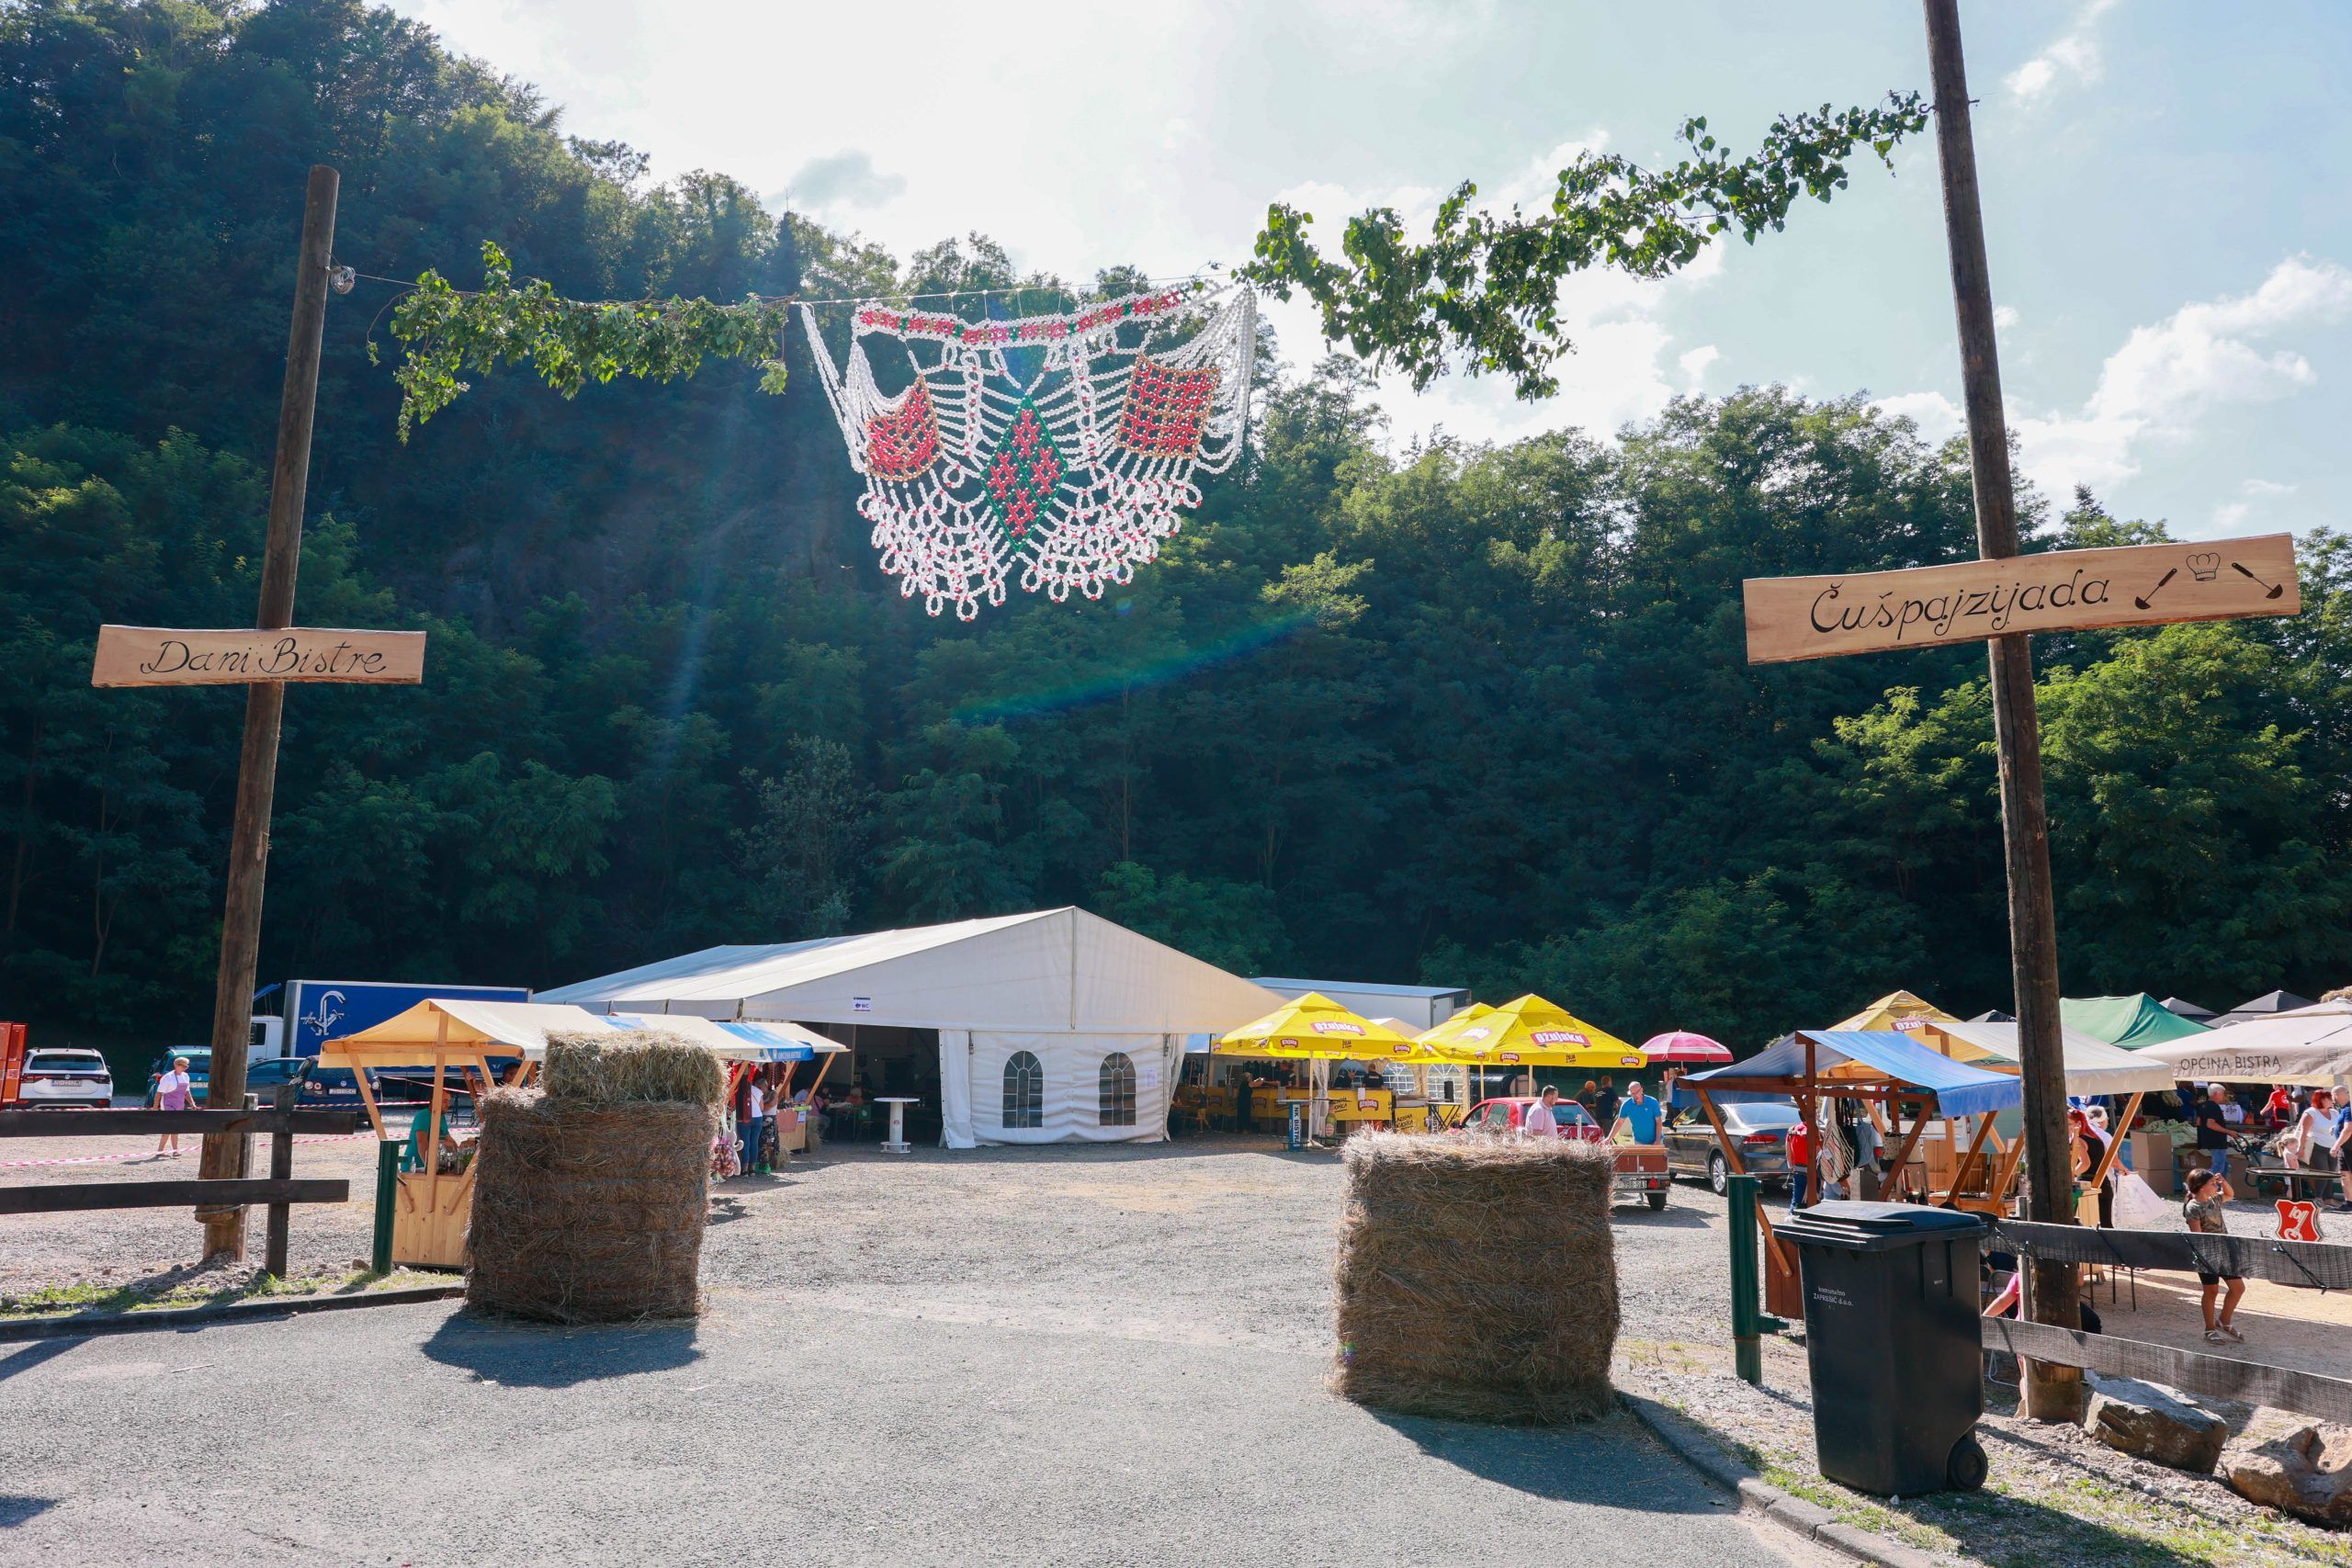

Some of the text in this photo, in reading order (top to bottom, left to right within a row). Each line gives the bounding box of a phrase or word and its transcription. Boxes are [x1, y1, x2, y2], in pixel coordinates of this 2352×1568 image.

[1811, 569, 2110, 640] Čušpajzijada
[140, 637, 387, 674] Dani Bistre
[2180, 1055, 2281, 1070] OPĆINA BISTRA
[1294, 1107, 1300, 1117] NK
